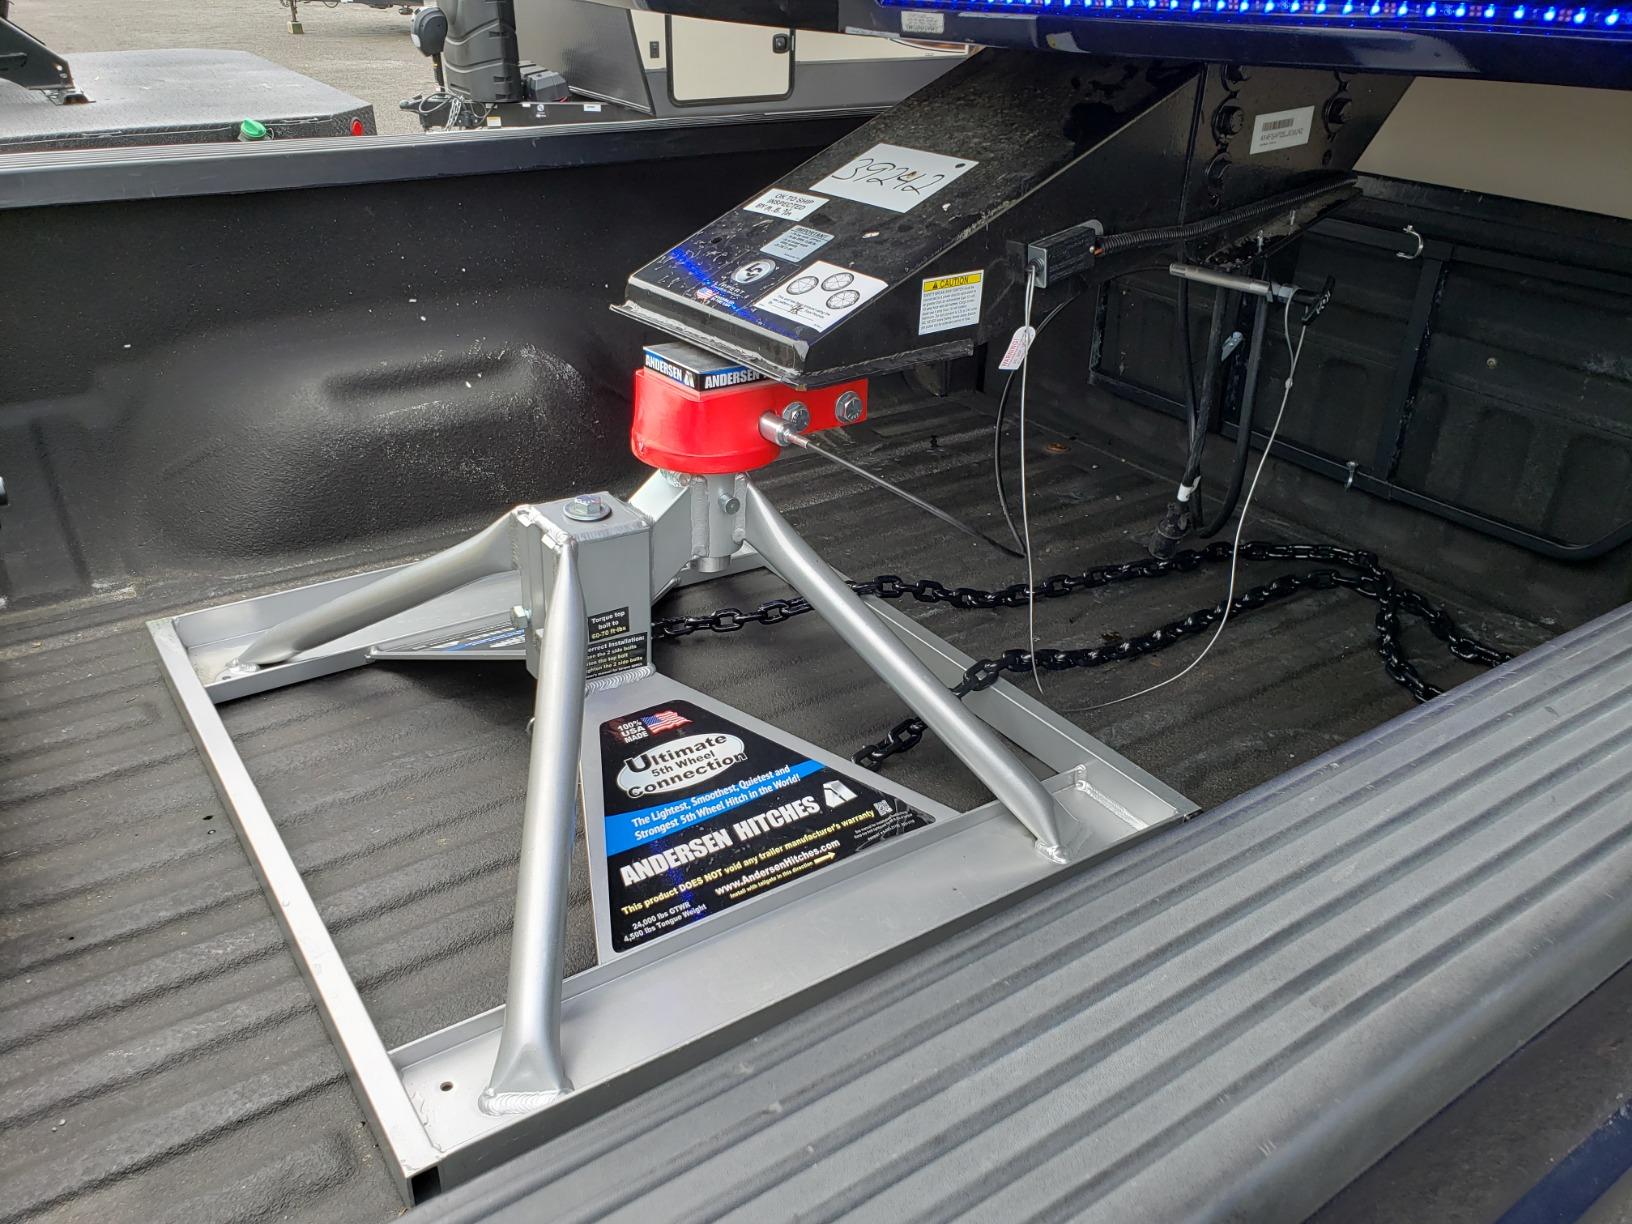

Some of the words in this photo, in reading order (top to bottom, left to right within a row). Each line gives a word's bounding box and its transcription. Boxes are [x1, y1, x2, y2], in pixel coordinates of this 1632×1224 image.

[832, 158, 945, 195] 39242
[940, 276, 969, 288] CAUTION
[645, 354, 682, 381] ANDERSEN
[704, 368, 760, 389] ANDERSEN
[592, 614, 613, 624] Torque
[598, 622, 610, 630] bolt
[617, 720, 642, 731] 100%
[622, 725, 646, 738] USA
[624, 731, 649, 743] MADE
[625, 735, 727, 773] Ultimate
[651, 765, 674, 777] 5th
[675, 750, 716, 769] Wheel
[627, 752, 748, 798] Connection
[631, 816, 650, 828] The
[651, 801, 691, 822] Lightest,
[691, 783, 739, 806] Smoothest,
[739, 772, 774, 790] Quietest
[775, 765, 790, 778] and
[634, 819, 679, 841] Strongest
[680, 813, 696, 825] 5th
[696, 802, 725, 819] Wheel
[726, 792, 749, 809] Hitch
[750, 789, 757, 799] in
[758, 783, 773, 796] the
[773, 774, 800, 791] World!
[620, 828, 734, 887] ANDERSEN
[733, 795, 820, 842] HITCHES
[621, 902, 643, 915] This
[644, 887, 679, 908] product
[679, 877, 704, 892] DOES
[704, 868, 723, 883] NOT
[724, 861, 742, 874] void
[743, 856, 757, 867] any
[758, 846, 783, 861] trailer
[784, 823, 841, 852] manufacturer's
[841, 809, 875, 827] warranty
[715, 839, 840, 895] www.AndersenHitches.com
[729, 888, 746, 899] Install
[792, 861, 813, 873] direction
[623, 929, 643, 943] 4,500
[644, 925, 656, 934] lbs
[656, 914, 682, 930] Tongue
[682, 903, 707, 918] Weight
[632, 916, 656, 930] 24,000
[657, 911, 669, 921] lbs
[669, 901, 691, 915] GTWR
